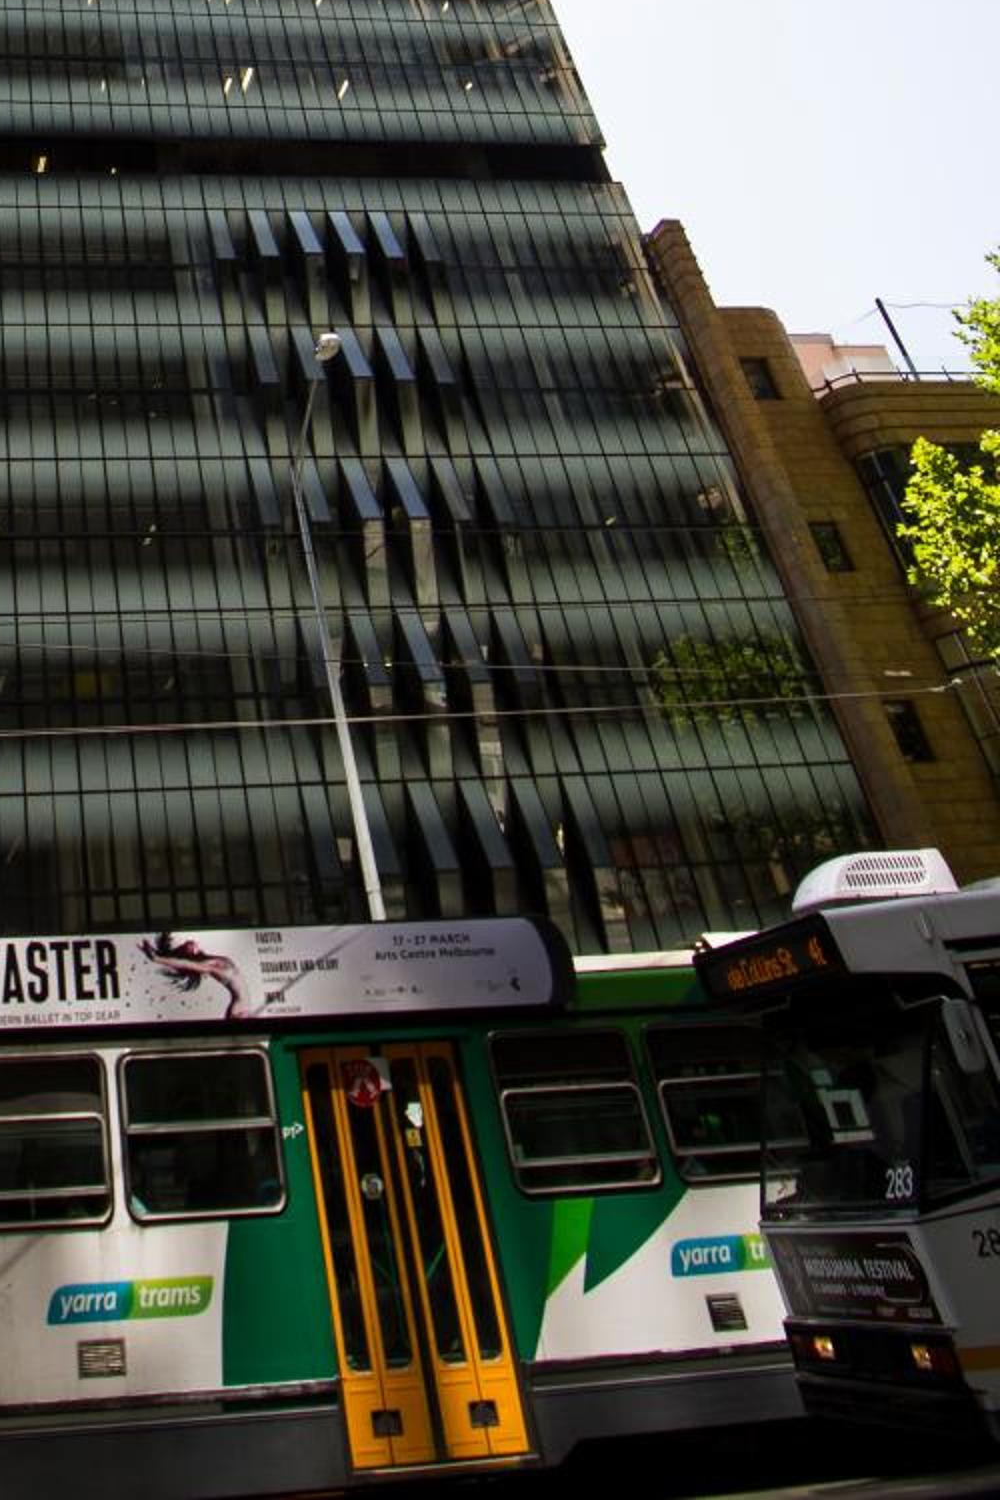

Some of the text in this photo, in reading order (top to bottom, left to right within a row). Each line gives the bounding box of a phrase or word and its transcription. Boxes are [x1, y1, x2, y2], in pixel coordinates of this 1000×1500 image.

[24, 1013, 60, 1024] BALLET
[885, 1164, 913, 1199] 283
[680, 1245, 731, 1274] yarra
[60, 1284, 201, 1320] yarra trams
